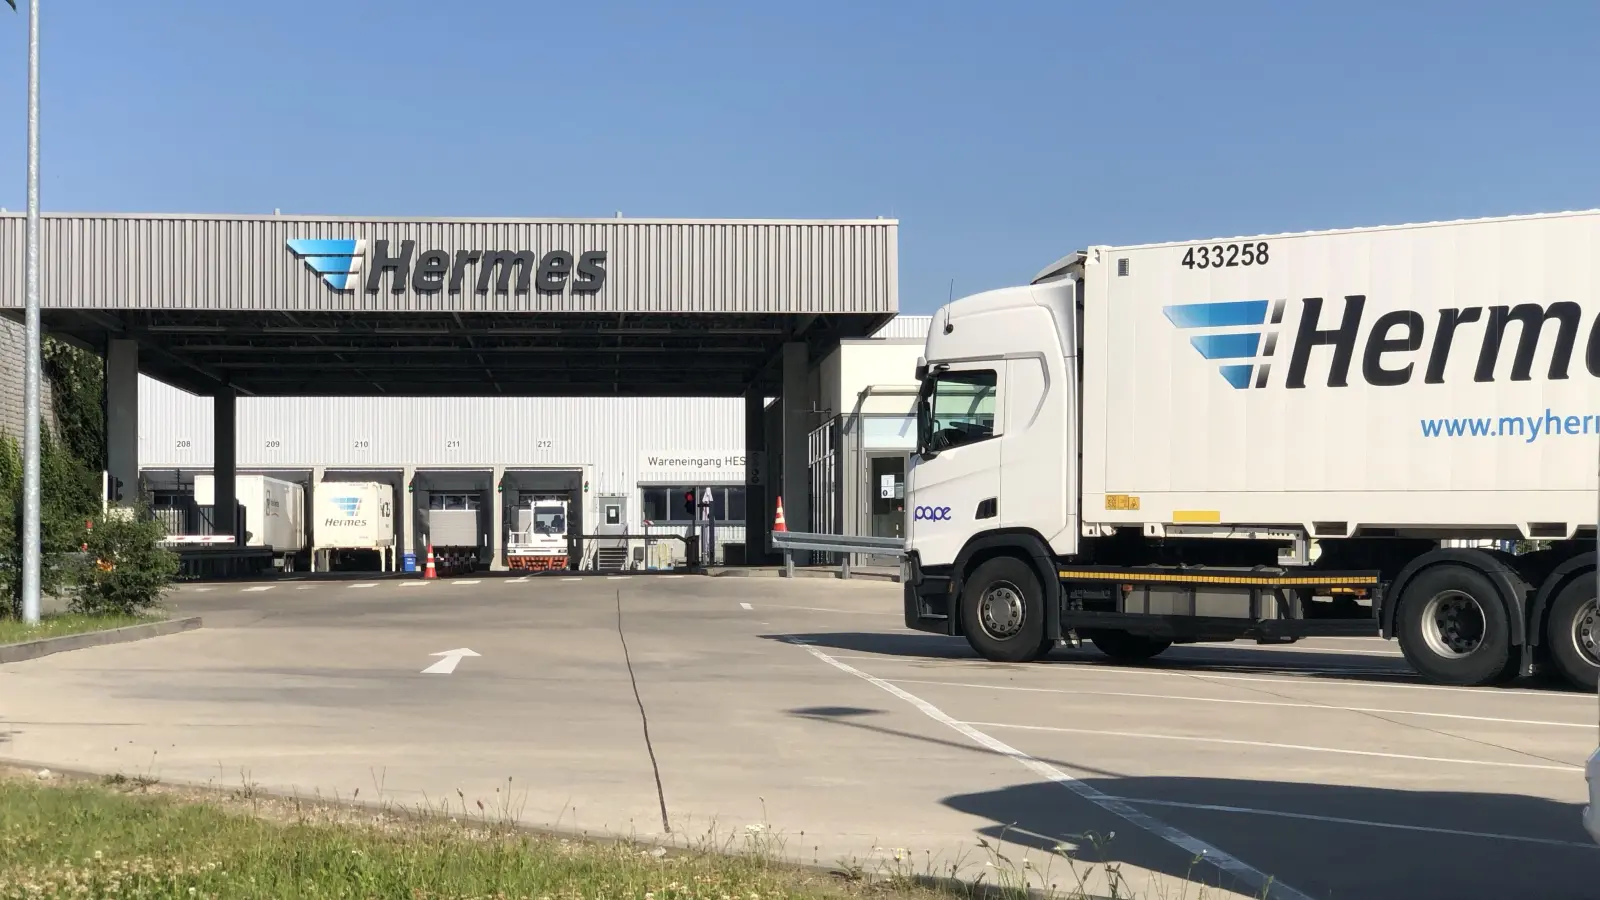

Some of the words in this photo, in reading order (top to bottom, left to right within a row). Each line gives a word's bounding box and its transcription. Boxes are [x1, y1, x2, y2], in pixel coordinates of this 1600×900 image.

[1182, 242, 1269, 270] 433258
[366, 240, 607, 296] Hermes
[1285, 295, 1599, 389] Herm
[1420, 408, 1599, 443] www.myher
[176, 440, 191, 448] 208
[266, 440, 280, 448] 209
[354, 440, 369, 448] 210
[447, 440, 460, 448] 211
[537, 440, 552, 448] 212
[648, 456, 722, 468] Wareneingang
[725, 456, 746, 466] HES
[915, 506, 951, 522] pape
[325, 518, 367, 527] Hermes
